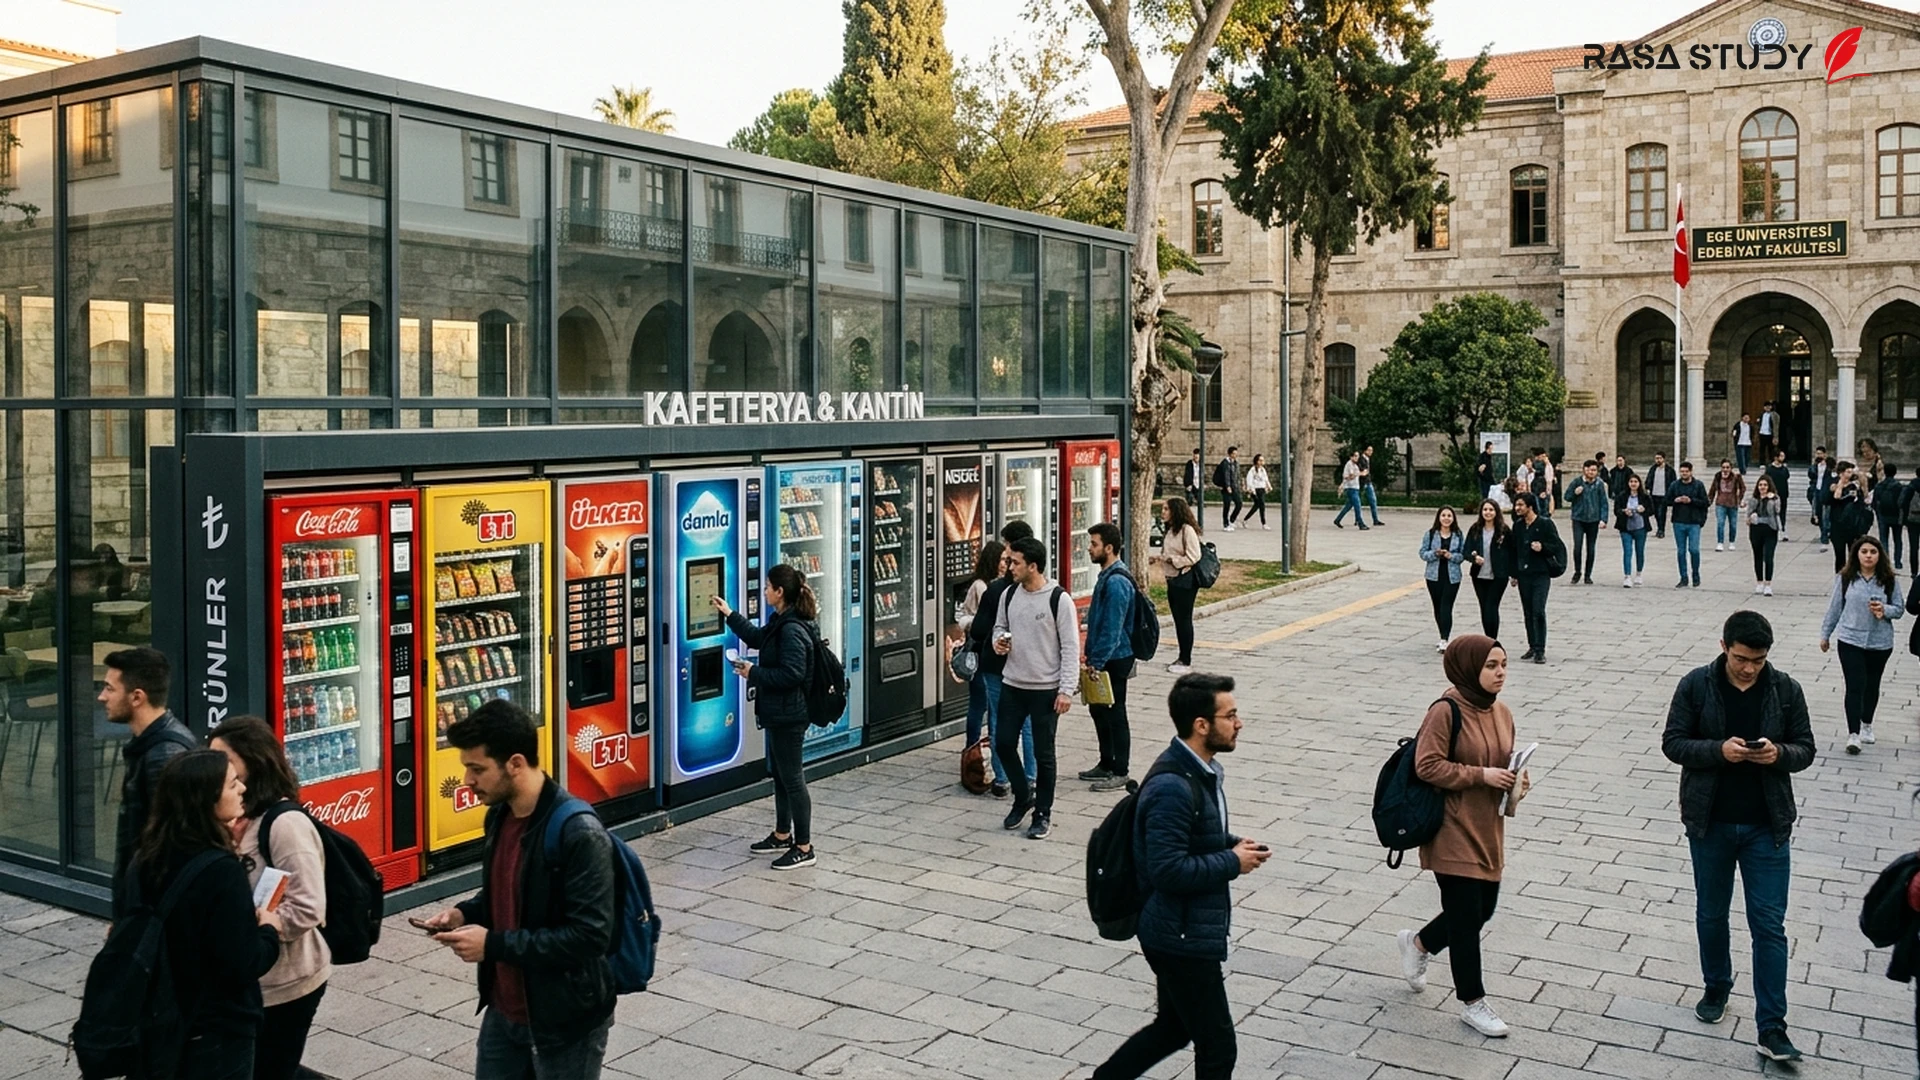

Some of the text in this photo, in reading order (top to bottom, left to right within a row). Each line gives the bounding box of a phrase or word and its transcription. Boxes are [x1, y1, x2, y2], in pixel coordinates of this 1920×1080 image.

[1706, 231, 1733, 243] EGE
[1698, 245, 1762, 258] EDEBİYAT
[644, 384, 924, 425] KAFETERYA & KANTİN
[570, 498, 643, 530] ÜLKER
[682, 510, 729, 531] damla
[202, 577, 228, 740] RÜNLER
